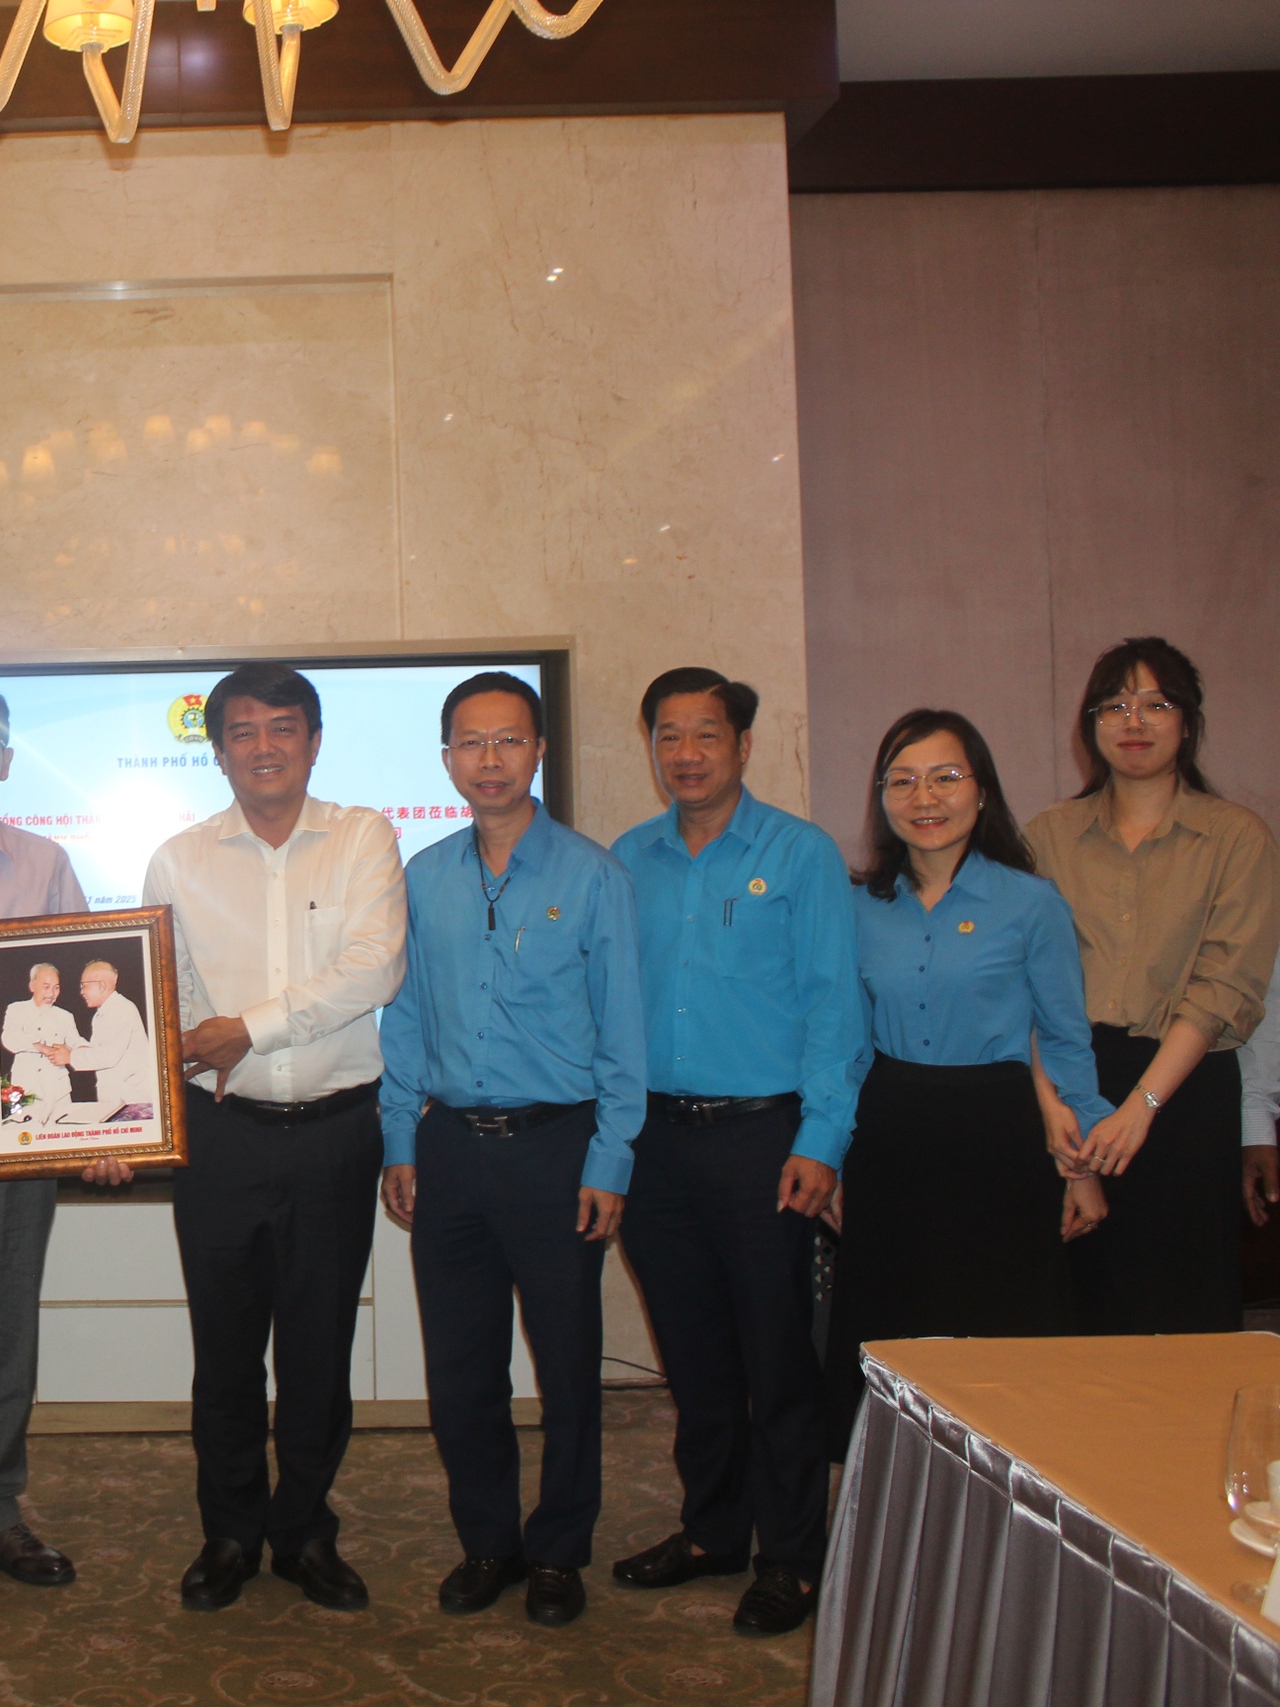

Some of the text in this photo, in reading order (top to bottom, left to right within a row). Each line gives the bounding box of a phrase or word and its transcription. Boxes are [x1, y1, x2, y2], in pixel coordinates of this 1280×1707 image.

[117, 755, 158, 768] THÀNH
[162, 752, 188, 768] PHỐ
[192, 752, 209, 767] HỒ
[25, 814, 53, 826] CÔNG
[55, 813, 73, 827] HỘI
[94, 895, 114, 904] năm
[115, 895, 136, 904] 2025
[35, 1133, 46, 1141] LIÊN
[61, 1131, 71, 1139] LAO
